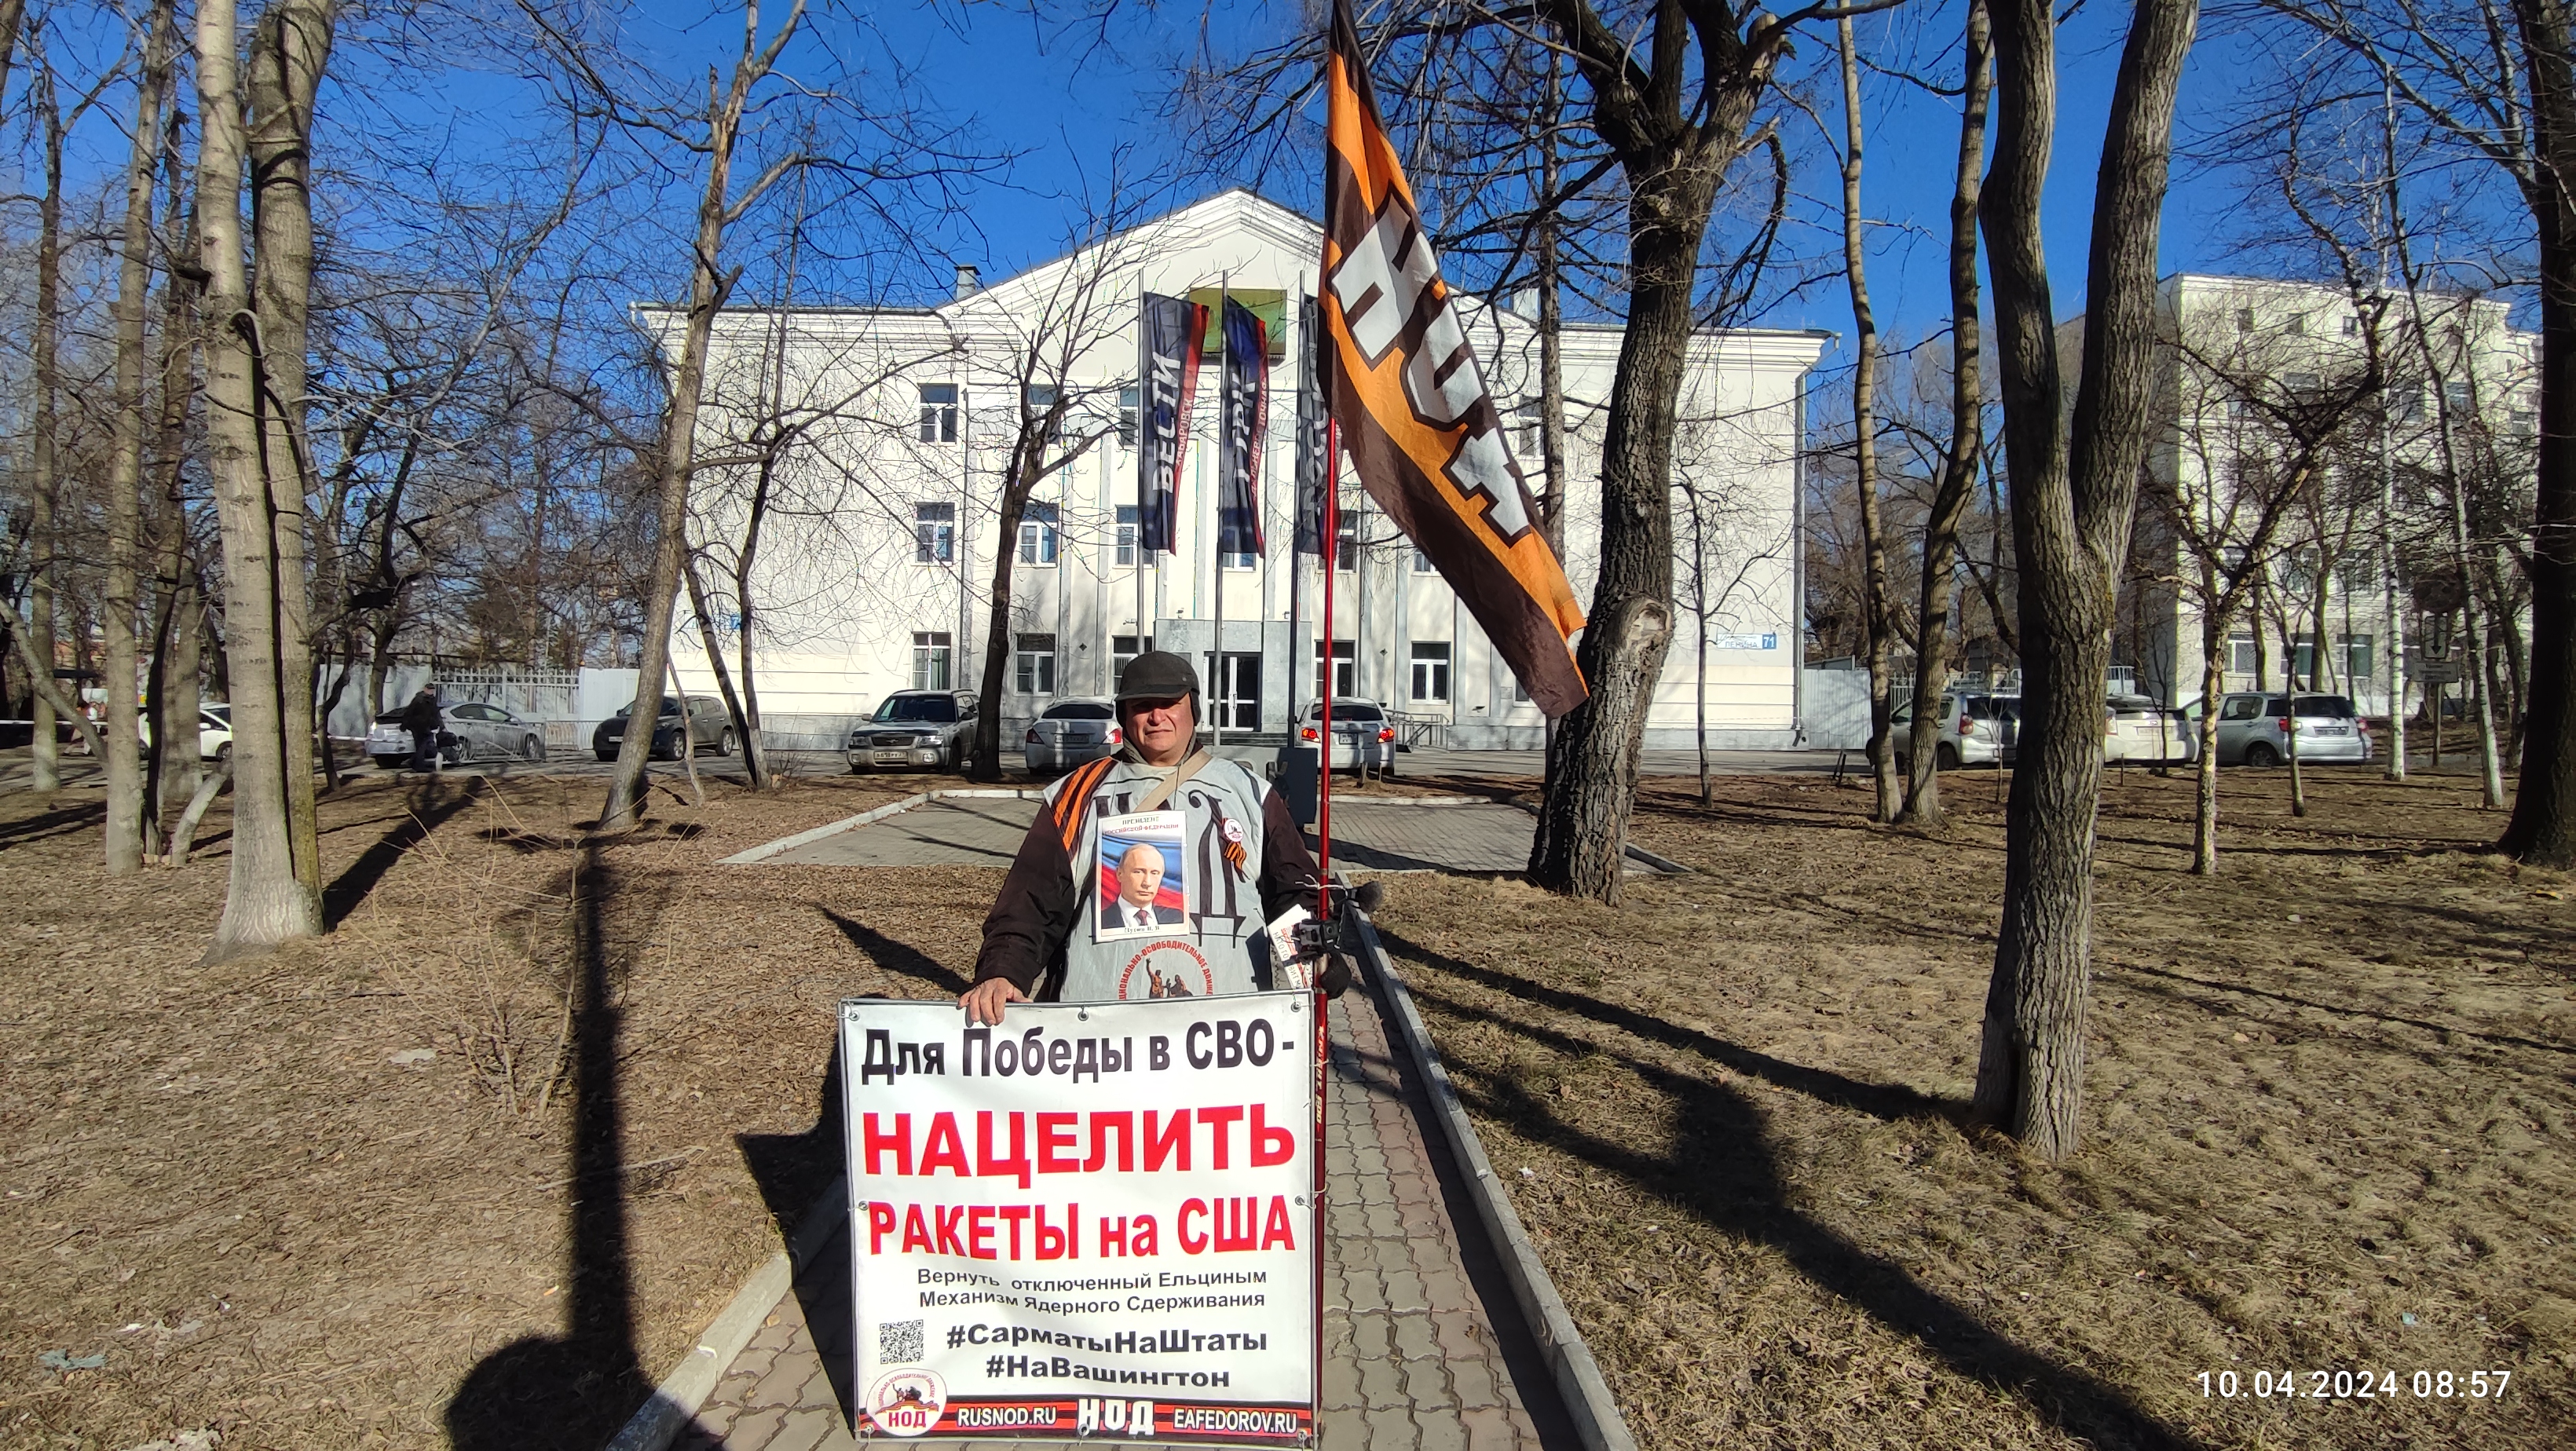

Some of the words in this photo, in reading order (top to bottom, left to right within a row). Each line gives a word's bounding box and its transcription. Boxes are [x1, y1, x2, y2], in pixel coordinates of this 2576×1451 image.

[1152, 351, 1180, 494] ВЕСТИ
[1763, 636, 1775, 648] 71
[862, 1029, 945, 1085] Для
[963, 1026, 1132, 1083] Победы
[1150, 1036, 1169, 1070] в
[864, 1104, 1294, 1189] НАЦЕЛИТЬ
[869, 1202, 1078, 1260] РАКЕТЫ
[1100, 1215, 1158, 1257] на
[1178, 1196, 1294, 1255] США
[918, 1269, 1000, 1286] Вернуть
[1011, 1274, 1151, 1292] отключенный
[1159, 1271, 1267, 1287] Ельциным
[920, 1291, 1019, 1307] Механизм
[1024, 1296, 1120, 1317] Ядерного
[1127, 1295, 1264, 1313] Сдерживания
[947, 1325, 1266, 1354] #СарматыНаШтаты
[987, 1356, 1228, 1387] #НаВашингтон
[887, 1411, 927, 1428] НОД
[957, 1407, 1056, 1427] RUSNOD.RU
[1077, 1398, 1155, 1436] НОД
[1174, 1409, 1297, 1433] EAFEDOROV.RU
